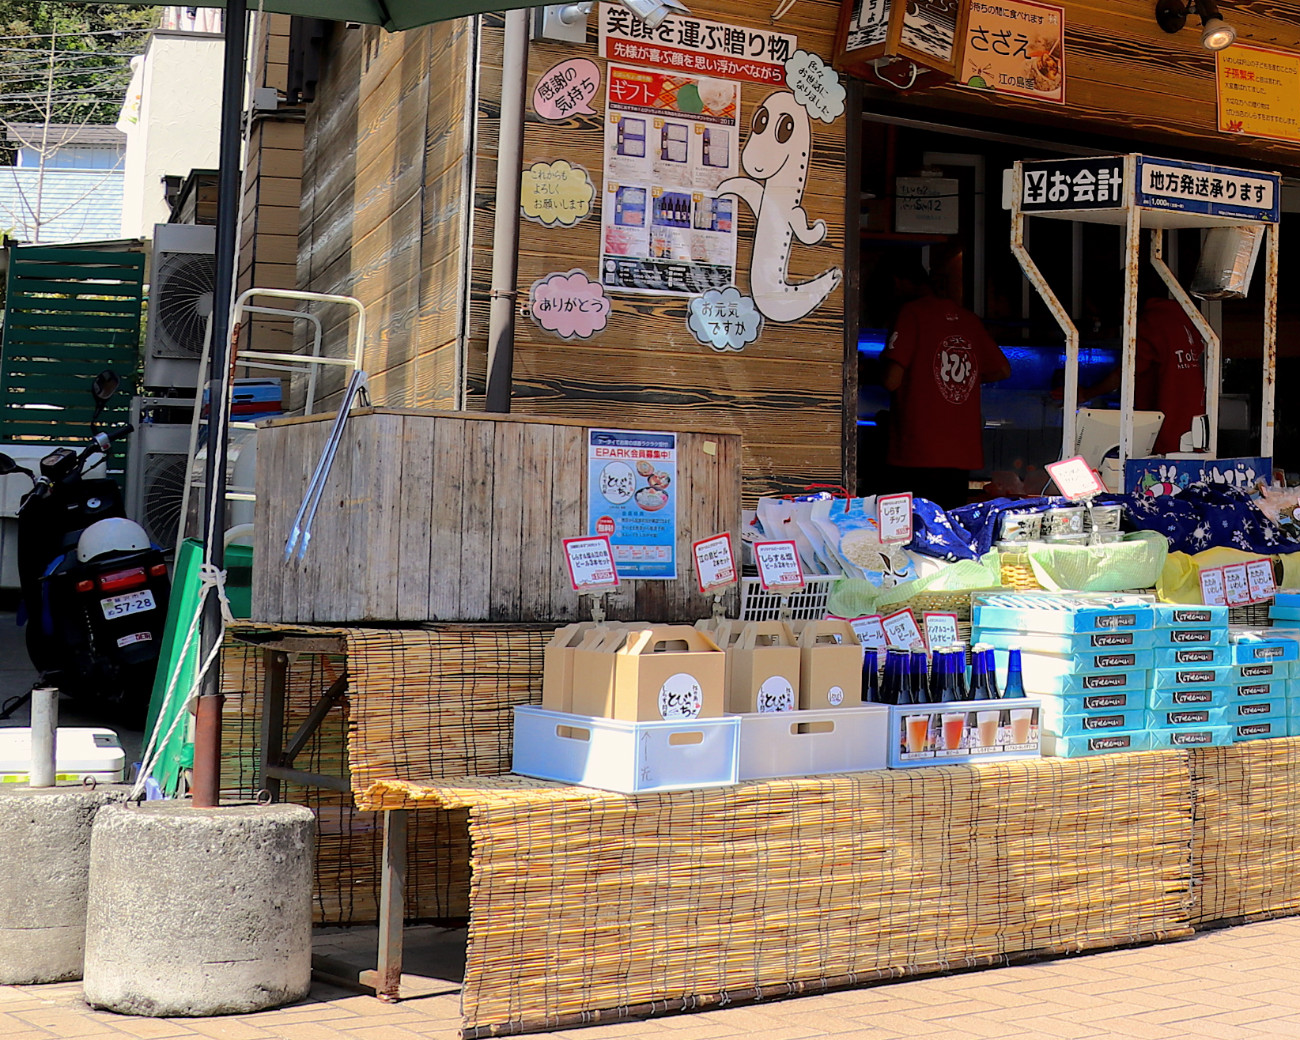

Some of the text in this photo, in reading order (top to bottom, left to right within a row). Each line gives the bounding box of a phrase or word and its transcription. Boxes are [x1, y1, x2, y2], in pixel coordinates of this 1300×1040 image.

[606, 7, 789, 62] 笑顔を運ぶ贈り物
[970, 25, 1031, 60] さざえ
[614, 42, 783, 81] 先様が喜ぶ顔を思い浮かべながら
[538, 65, 578, 103] 感謝の
[611, 80, 654, 104] ギフト
[555, 77, 597, 114] 気持ち
[796, 80, 830, 116] なりました
[531, 170, 568, 181] これからも
[533, 185, 560, 195] よろしく
[1150, 170, 1265, 203] 地方発送承ります
[534, 198, 586, 211] お願いします
[539, 297, 604, 313] ありがとう
[702, 301, 740, 318] お元気
[708, 321, 747, 337] ですか
[883, 506, 900, 516] しらす
[890, 513, 907, 525] チップ
[114, 598, 152, 614] 57-28
[889, 623, 906, 636] しらす
[898, 629, 916, 642] ビール
